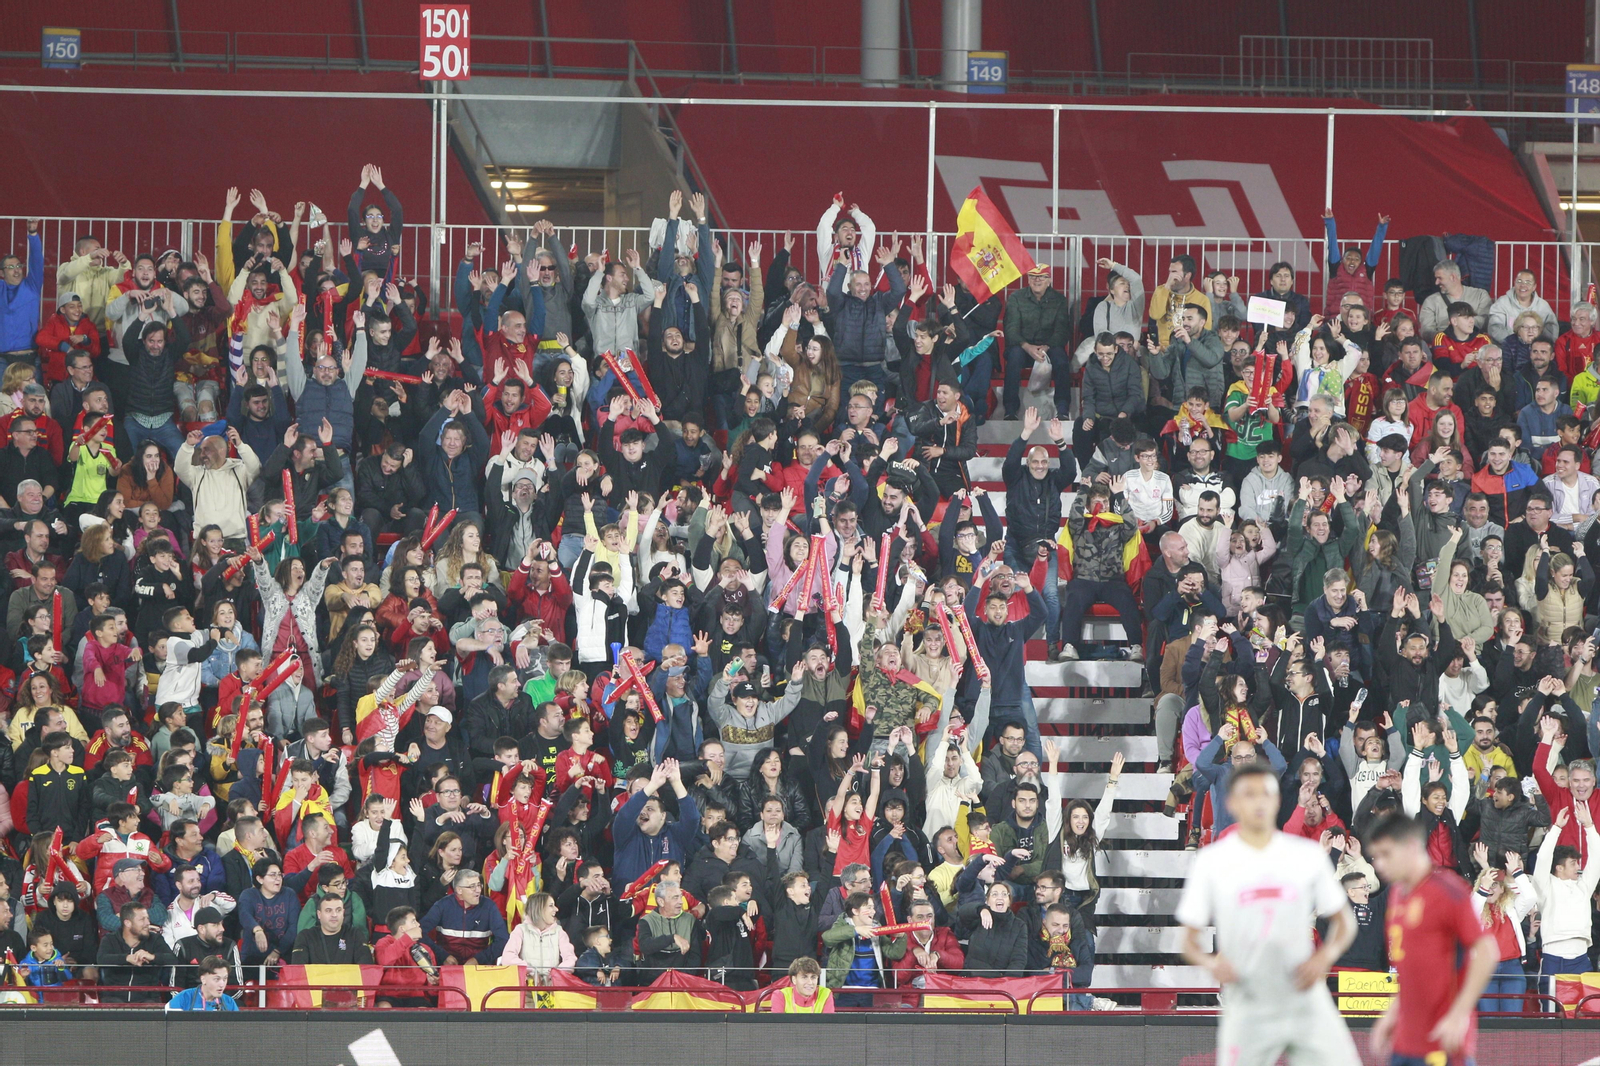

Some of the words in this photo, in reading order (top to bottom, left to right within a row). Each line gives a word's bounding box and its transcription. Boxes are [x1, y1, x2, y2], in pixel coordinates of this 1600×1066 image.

[423, 9, 459, 38] 150
[47, 43, 78, 58] 150
[422, 45, 462, 77] 50
[971, 66, 1002, 81] 149
[1569, 79, 1600, 93] 148
